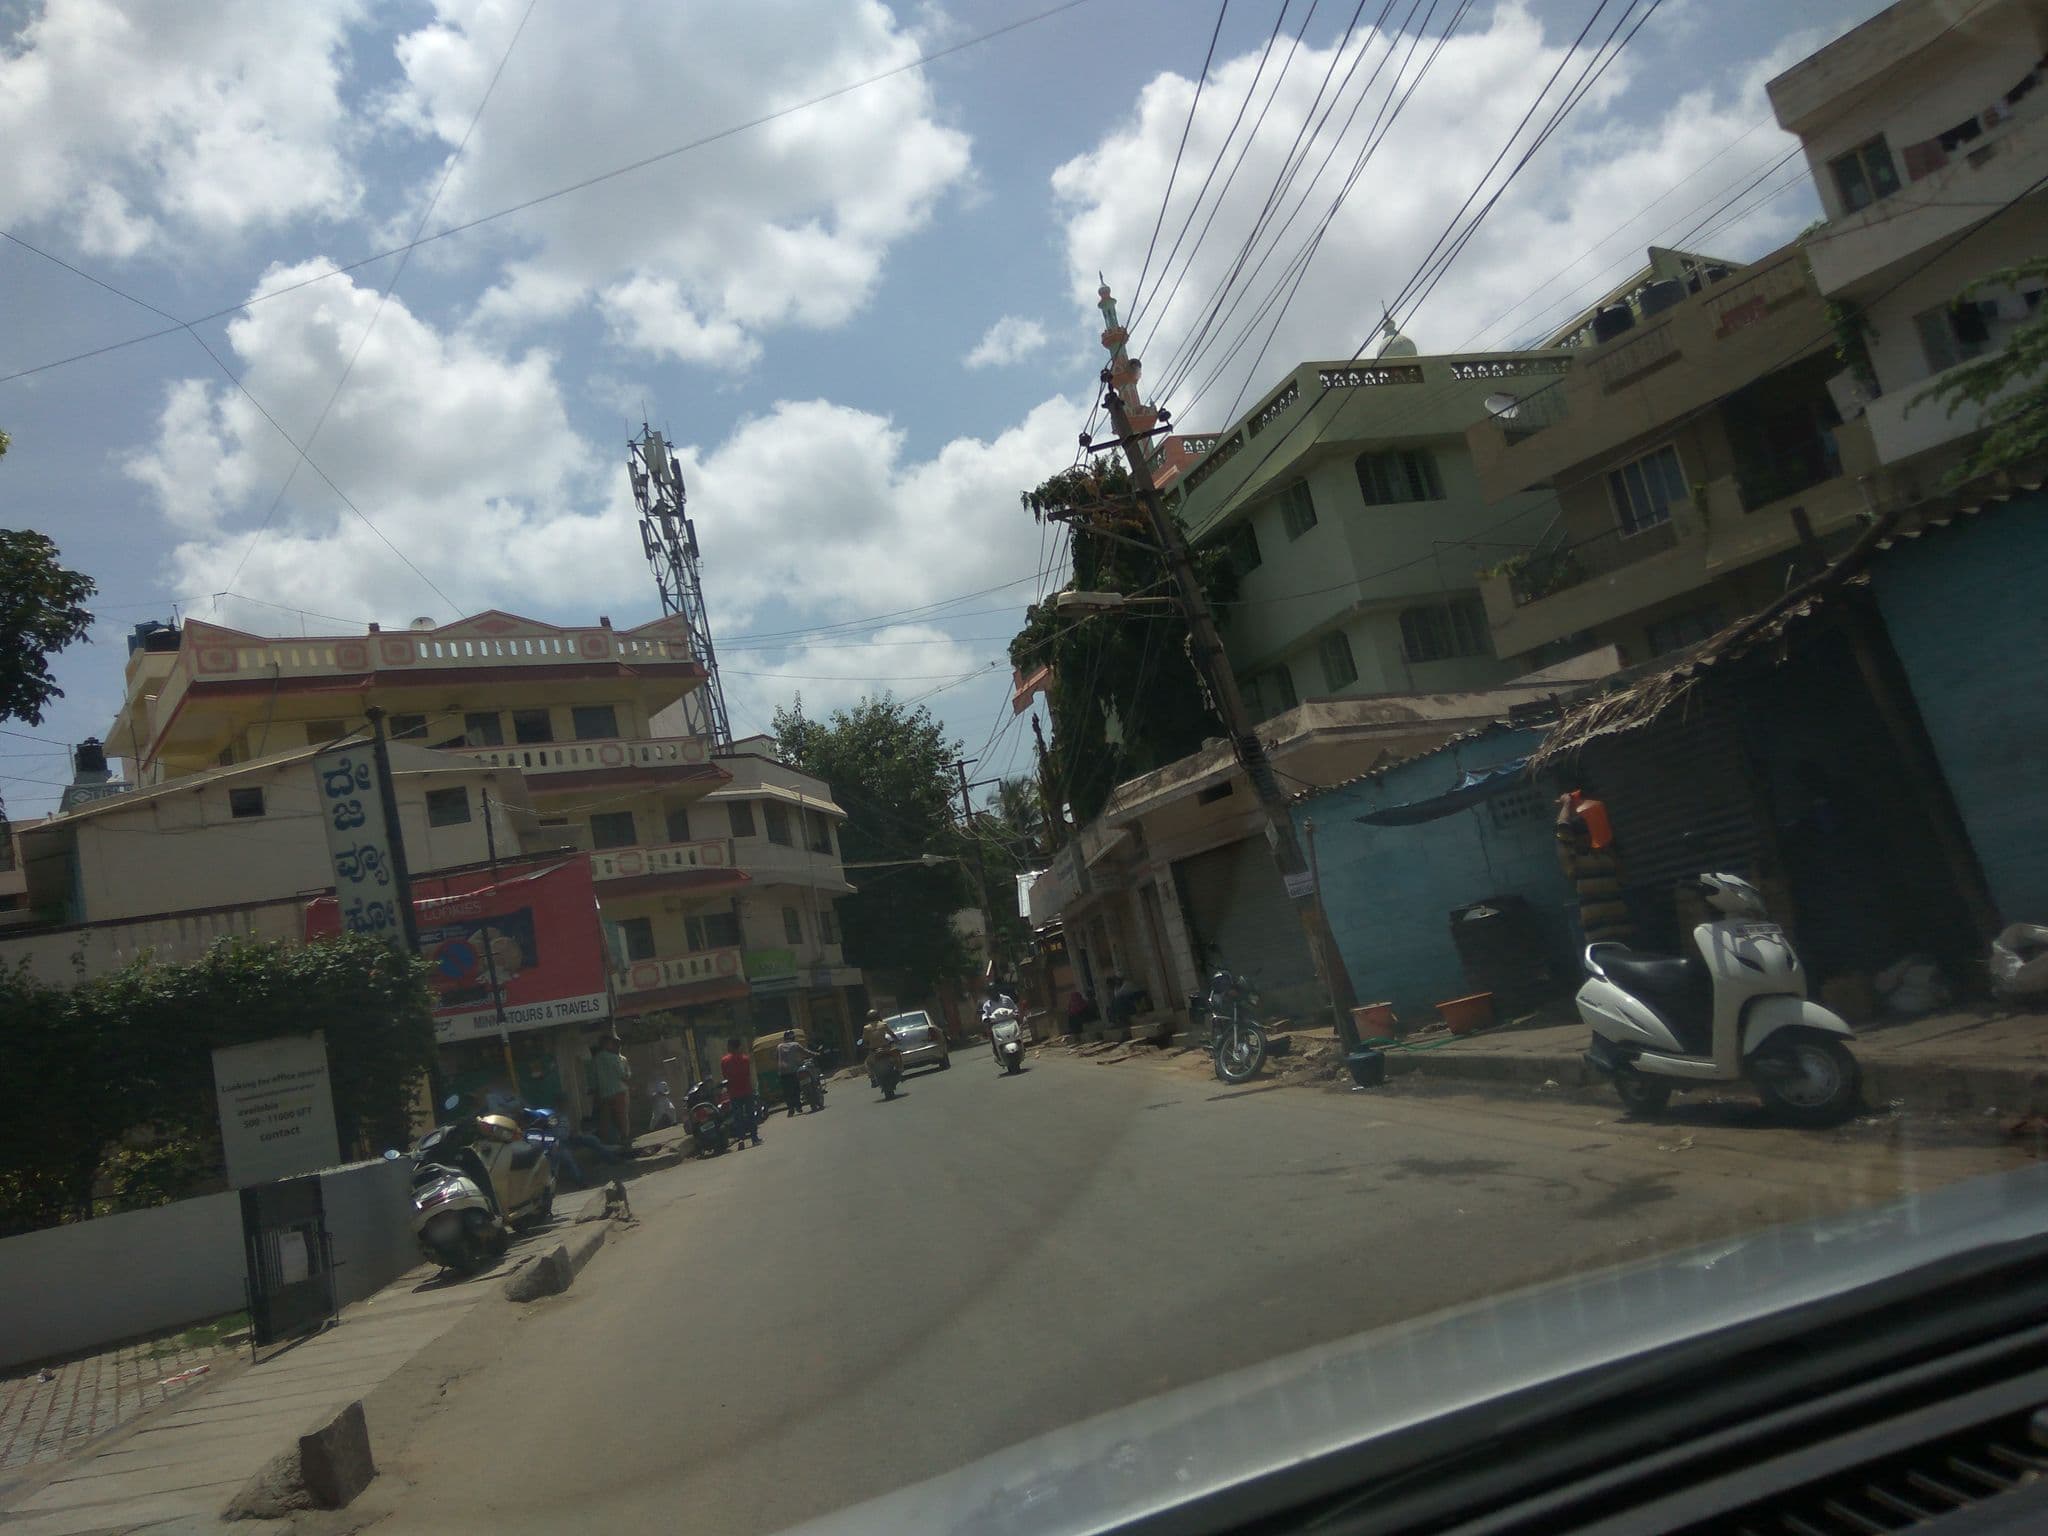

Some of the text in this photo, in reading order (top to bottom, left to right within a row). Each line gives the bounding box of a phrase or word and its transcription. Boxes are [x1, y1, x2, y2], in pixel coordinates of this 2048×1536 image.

[508, 1008, 544, 1024] TOURS
[546, 1006, 553, 1018] &
[555, 999, 600, 1017] TRAVELS
[271, 1073, 296, 1083] office
[260, 1126, 300, 1141] contact
